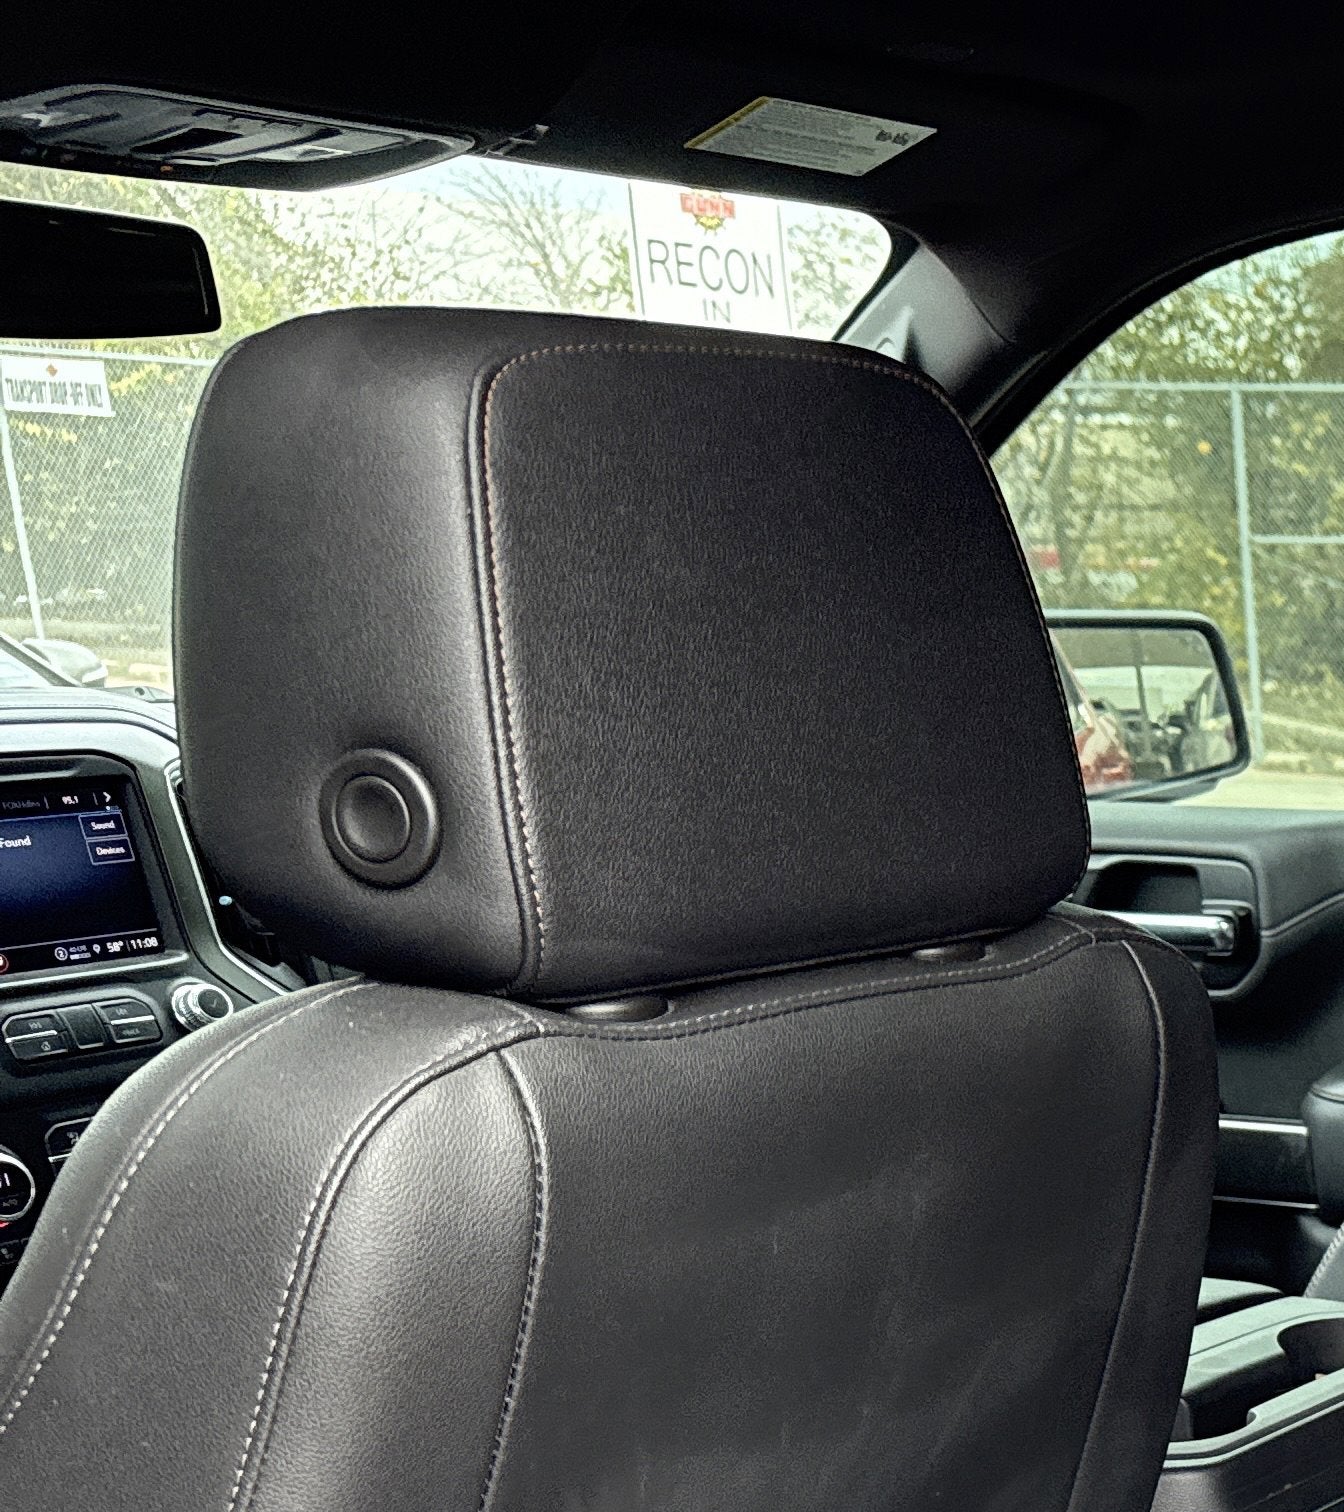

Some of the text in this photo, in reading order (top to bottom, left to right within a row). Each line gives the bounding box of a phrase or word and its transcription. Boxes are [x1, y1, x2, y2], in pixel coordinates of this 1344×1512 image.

[680, 193, 735, 219] GUNN
[647, 238, 774, 298] RECON
[702, 299, 731, 323] IN
[5, 378, 47, 403] TRANSPORT
[91, 820, 115, 830] Sound
[0, 835, 32, 849] Found
[96, 846, 125, 855] Devices
